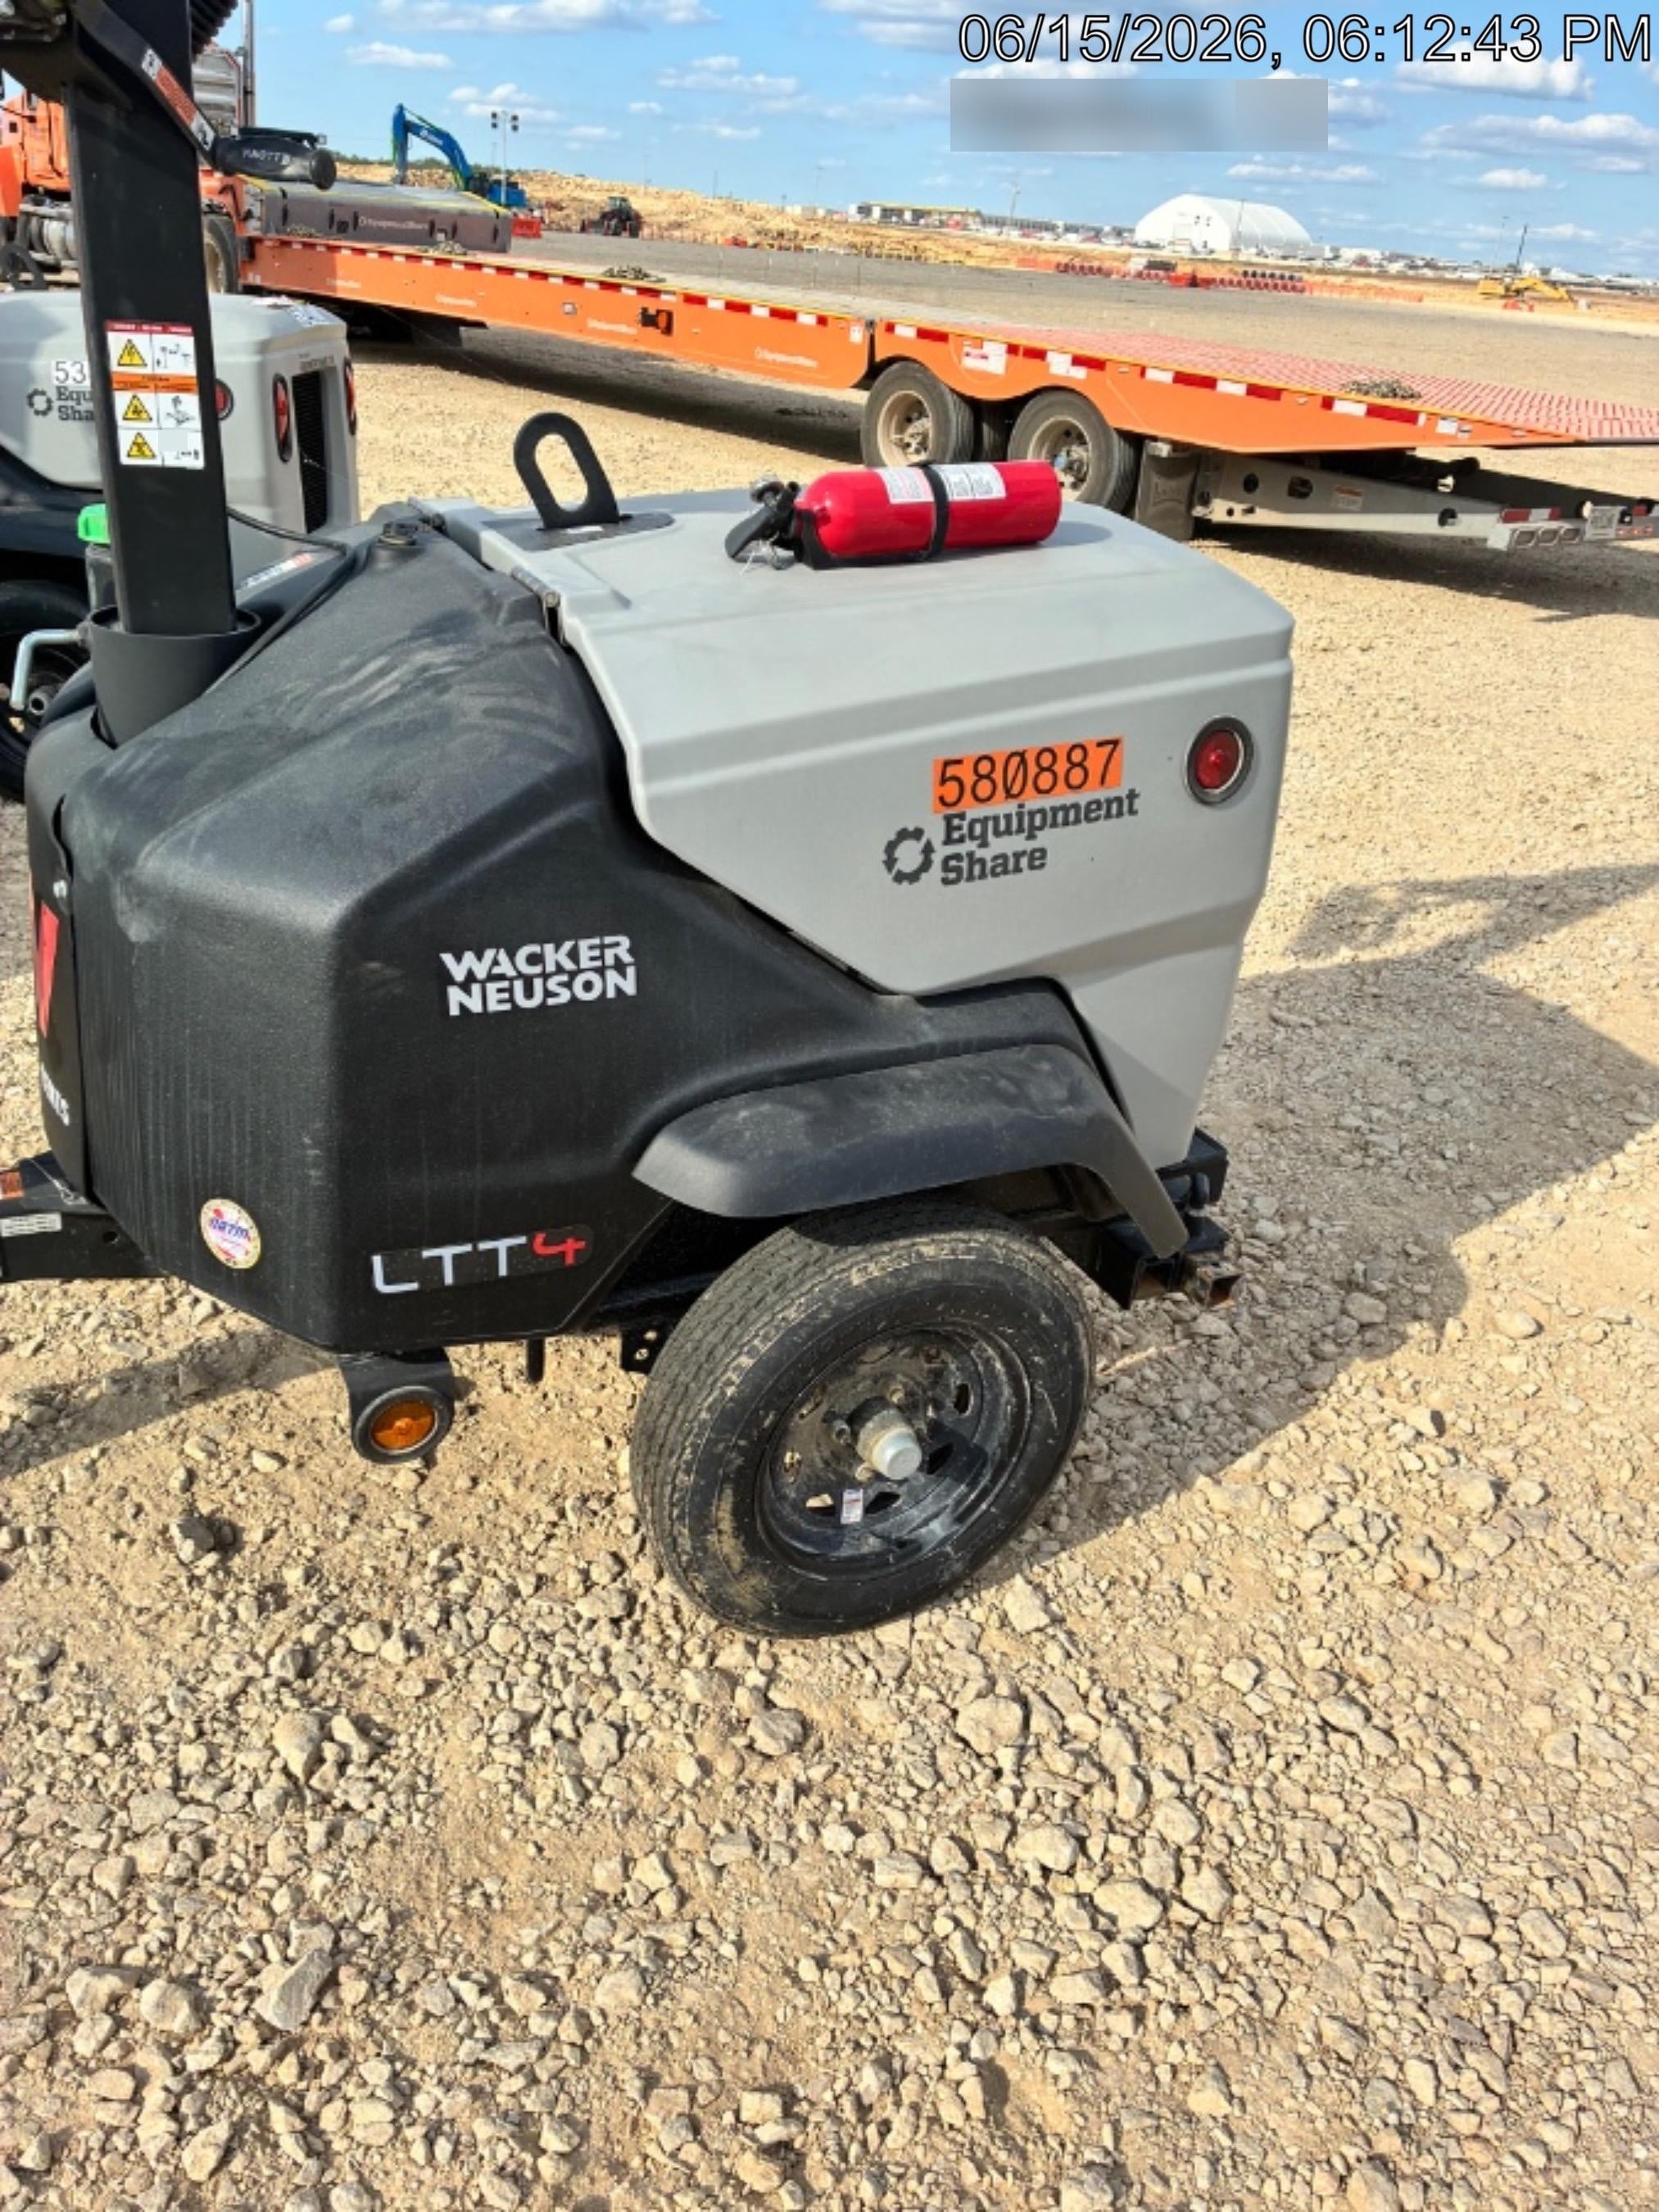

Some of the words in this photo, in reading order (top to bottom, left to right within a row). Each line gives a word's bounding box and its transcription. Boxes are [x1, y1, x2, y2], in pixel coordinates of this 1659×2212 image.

[937, 738, 1122, 808] 580887
[941, 787, 1141, 848] Equipment
[941, 846, 1048, 886] Share
[439, 934, 635, 982] WACKER
[446, 965, 637, 1017] NEUSON
